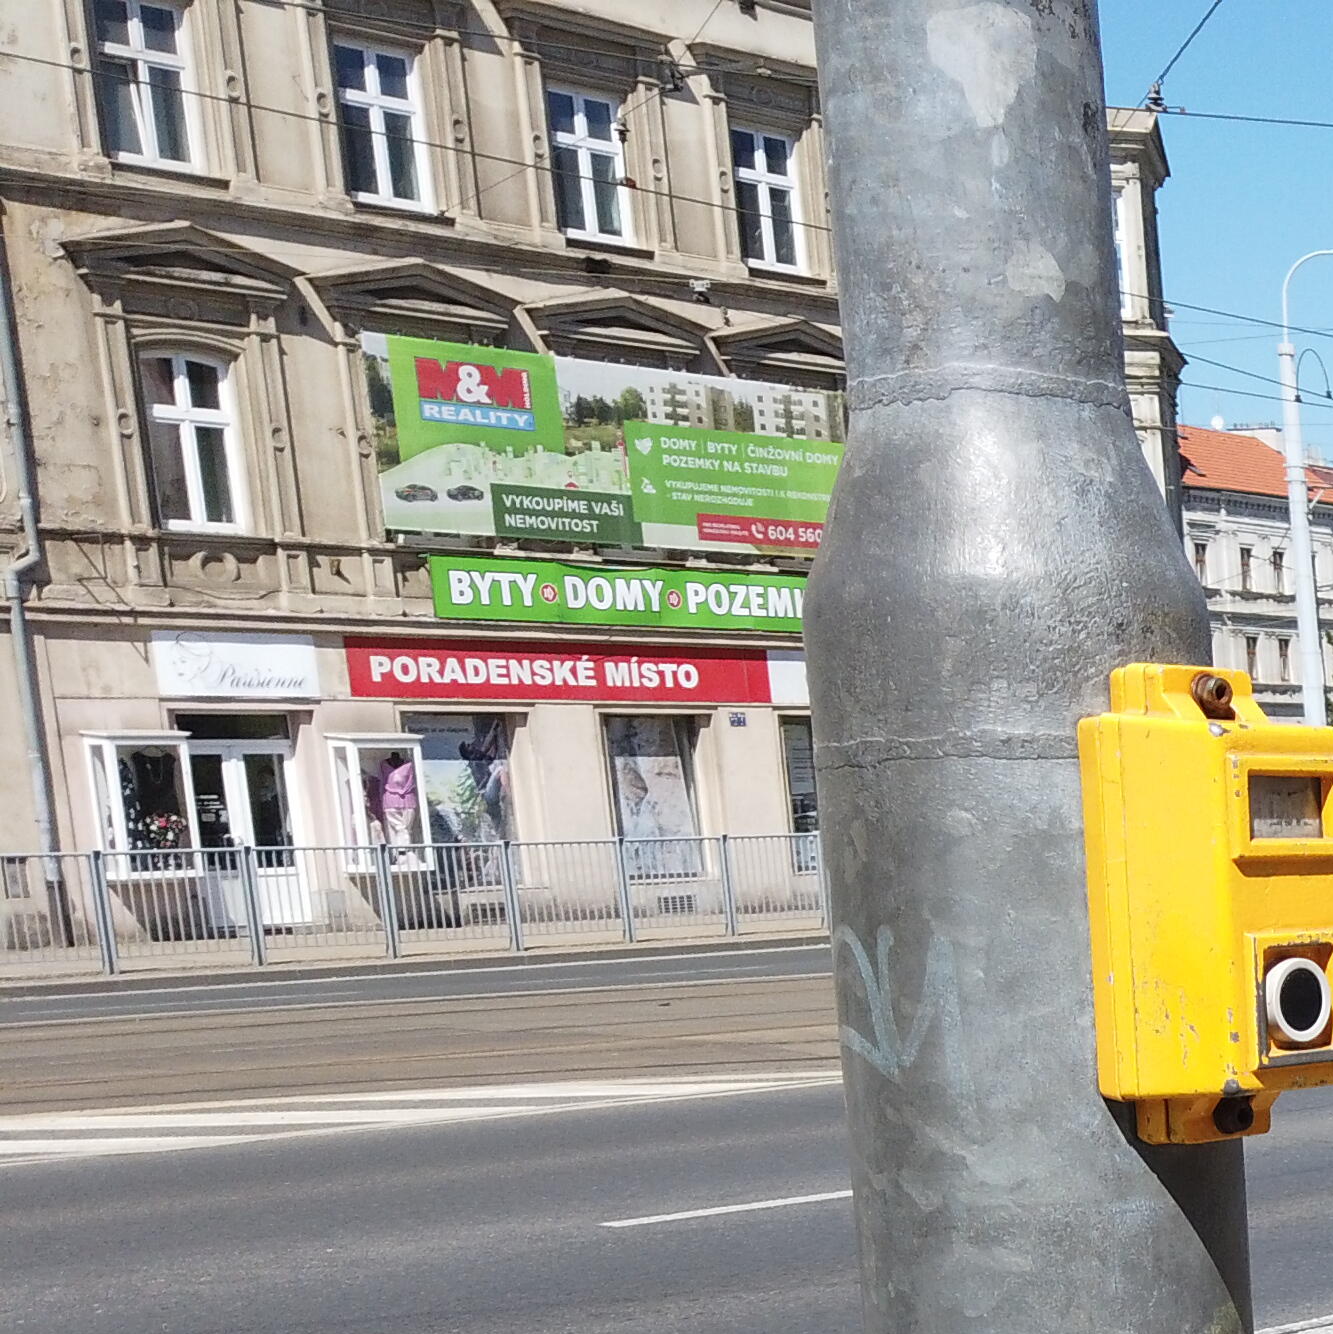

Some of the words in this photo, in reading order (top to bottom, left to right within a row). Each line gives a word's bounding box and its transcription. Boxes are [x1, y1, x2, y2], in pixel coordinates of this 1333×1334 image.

[413, 356, 532, 410] M&M
[422, 404, 528, 427] REALITY
[660, 437, 697, 451] DOMY
[707, 441, 738, 455] BYTY
[747, 443, 803, 461] ČINŽOVNÍ
[806, 452, 839, 465] DOMY
[662, 454, 720, 471] POZEMKY
[723, 461, 741, 473] NA
[744, 463, 789, 477] STAVBU
[502, 493, 589, 513] VYKOUPÍME
[591, 500, 624, 516] VAŠI
[504, 513, 600, 533] NEMOVITOST
[768, 525, 795, 541] 604
[448, 570, 537, 606] BYTY
[564, 574, 664, 613] DOMY
[219, 663, 306, 690] Parisienne
[369, 655, 597, 687] PORADENSKÉ
[604, 656, 699, 688] MÍSTO
